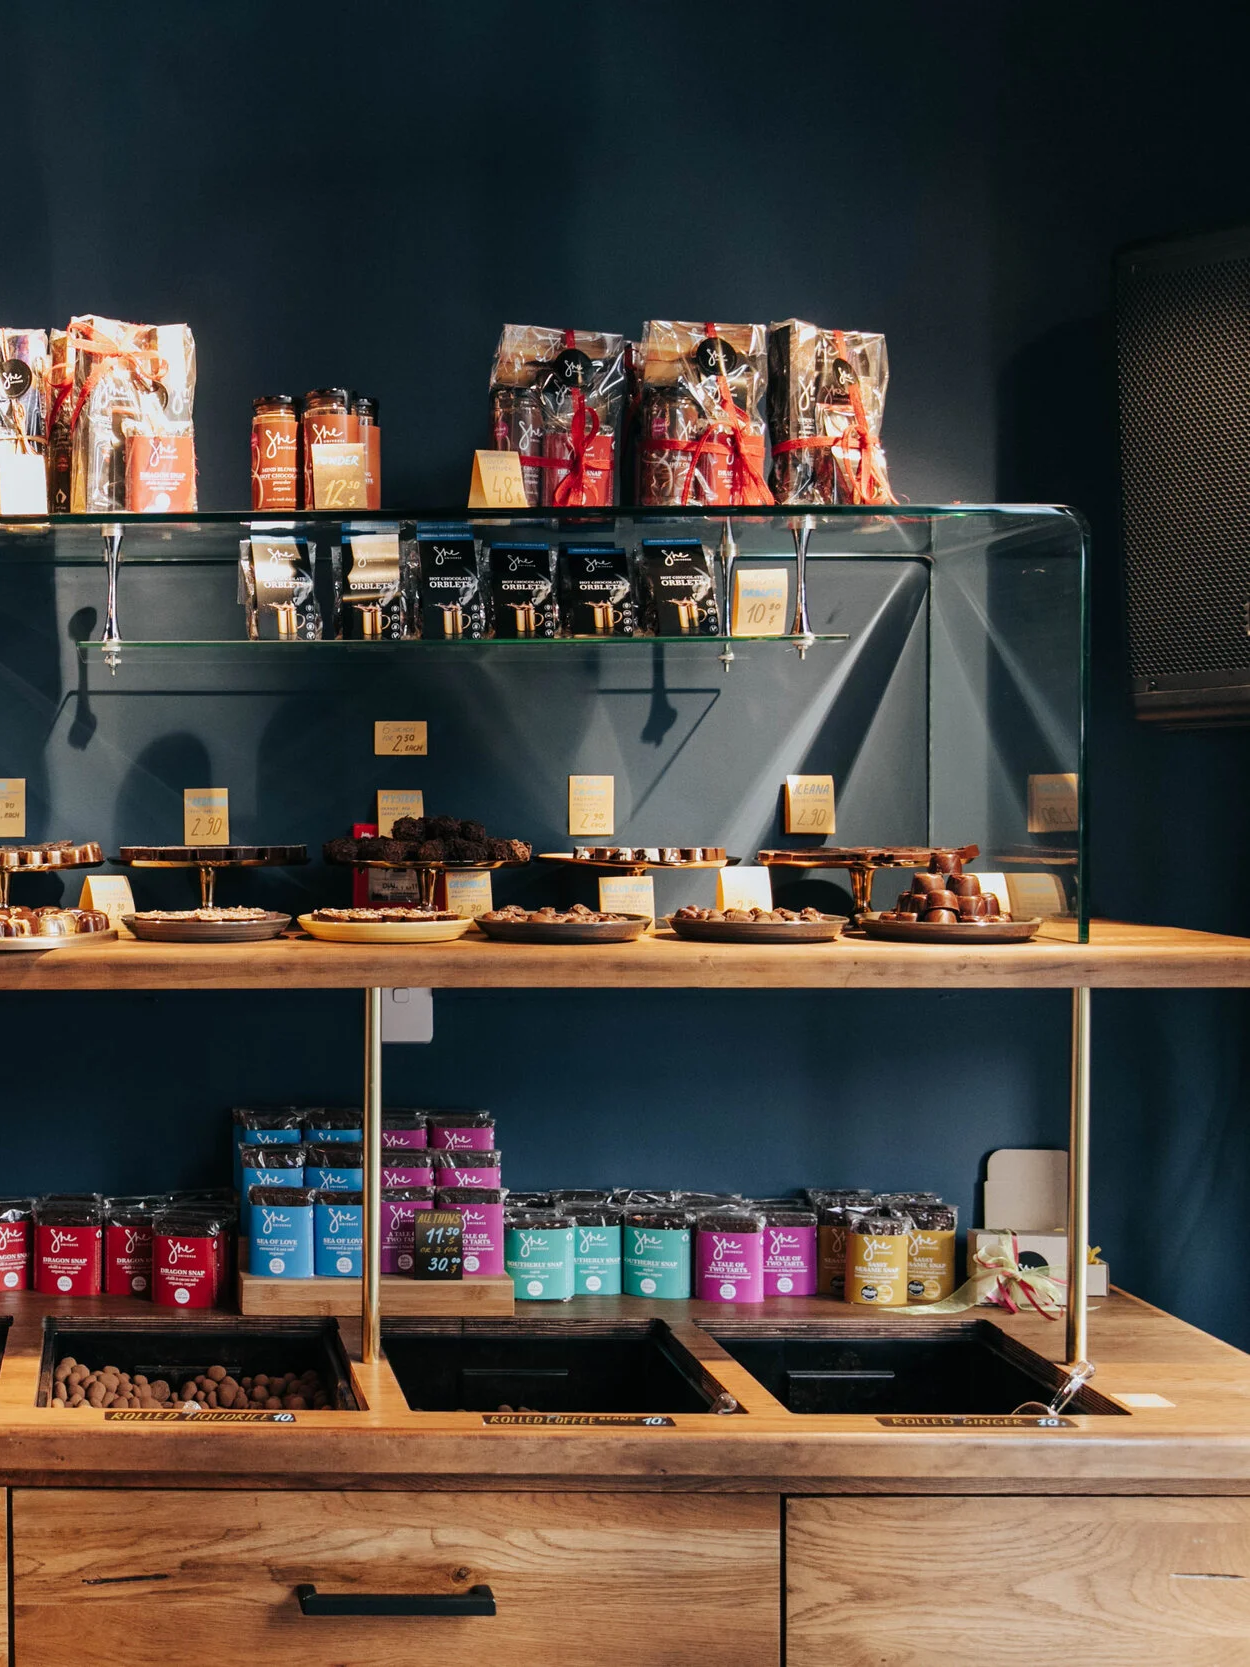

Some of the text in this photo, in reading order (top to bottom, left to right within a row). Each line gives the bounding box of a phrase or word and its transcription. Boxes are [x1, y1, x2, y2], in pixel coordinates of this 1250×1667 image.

[2, 372, 23, 389] She
[265, 429, 296, 458] She
[312, 423, 344, 444] She
[150, 438, 177, 468] She
[433, 545, 460, 565] She
[508, 554, 533, 571] She
[585, 557, 611, 572] She
[661, 549, 689, 566] She
[350, 582, 393, 590] ORBLETS
[190, 817, 223, 836] 2.90
[444, 1131, 471, 1149] She
[320, 1170, 347, 1189] She
[384, 1170, 411, 1187] She
[455, 1171, 483, 1187] She
[262, 1208, 290, 1234] She
[329, 1207, 357, 1233] She
[389, 1205, 414, 1230] She
[417, 1213, 462, 1224] ALL THINS
[51, 1229, 77, 1253] She
[520, 1232, 547, 1258] She
[579, 1229, 606, 1253] She
[634, 1230, 662, 1255] She
[712, 1235, 741, 1260] She
[770, 1230, 798, 1254] She
[864, 1236, 891, 1261] She
[908, 1232, 937, 1256] She
[168, 1239, 195, 1264] She
[111, 1412, 178, 1420] ROLLED
[184, 1412, 268, 1421] LIQUORICE
[490, 1415, 543, 1424] ROLLED
[546, 1415, 596, 1424] COFFEE
[892, 1417, 954, 1425] ROLLED
[962, 1418, 1027, 1426] GINGER
